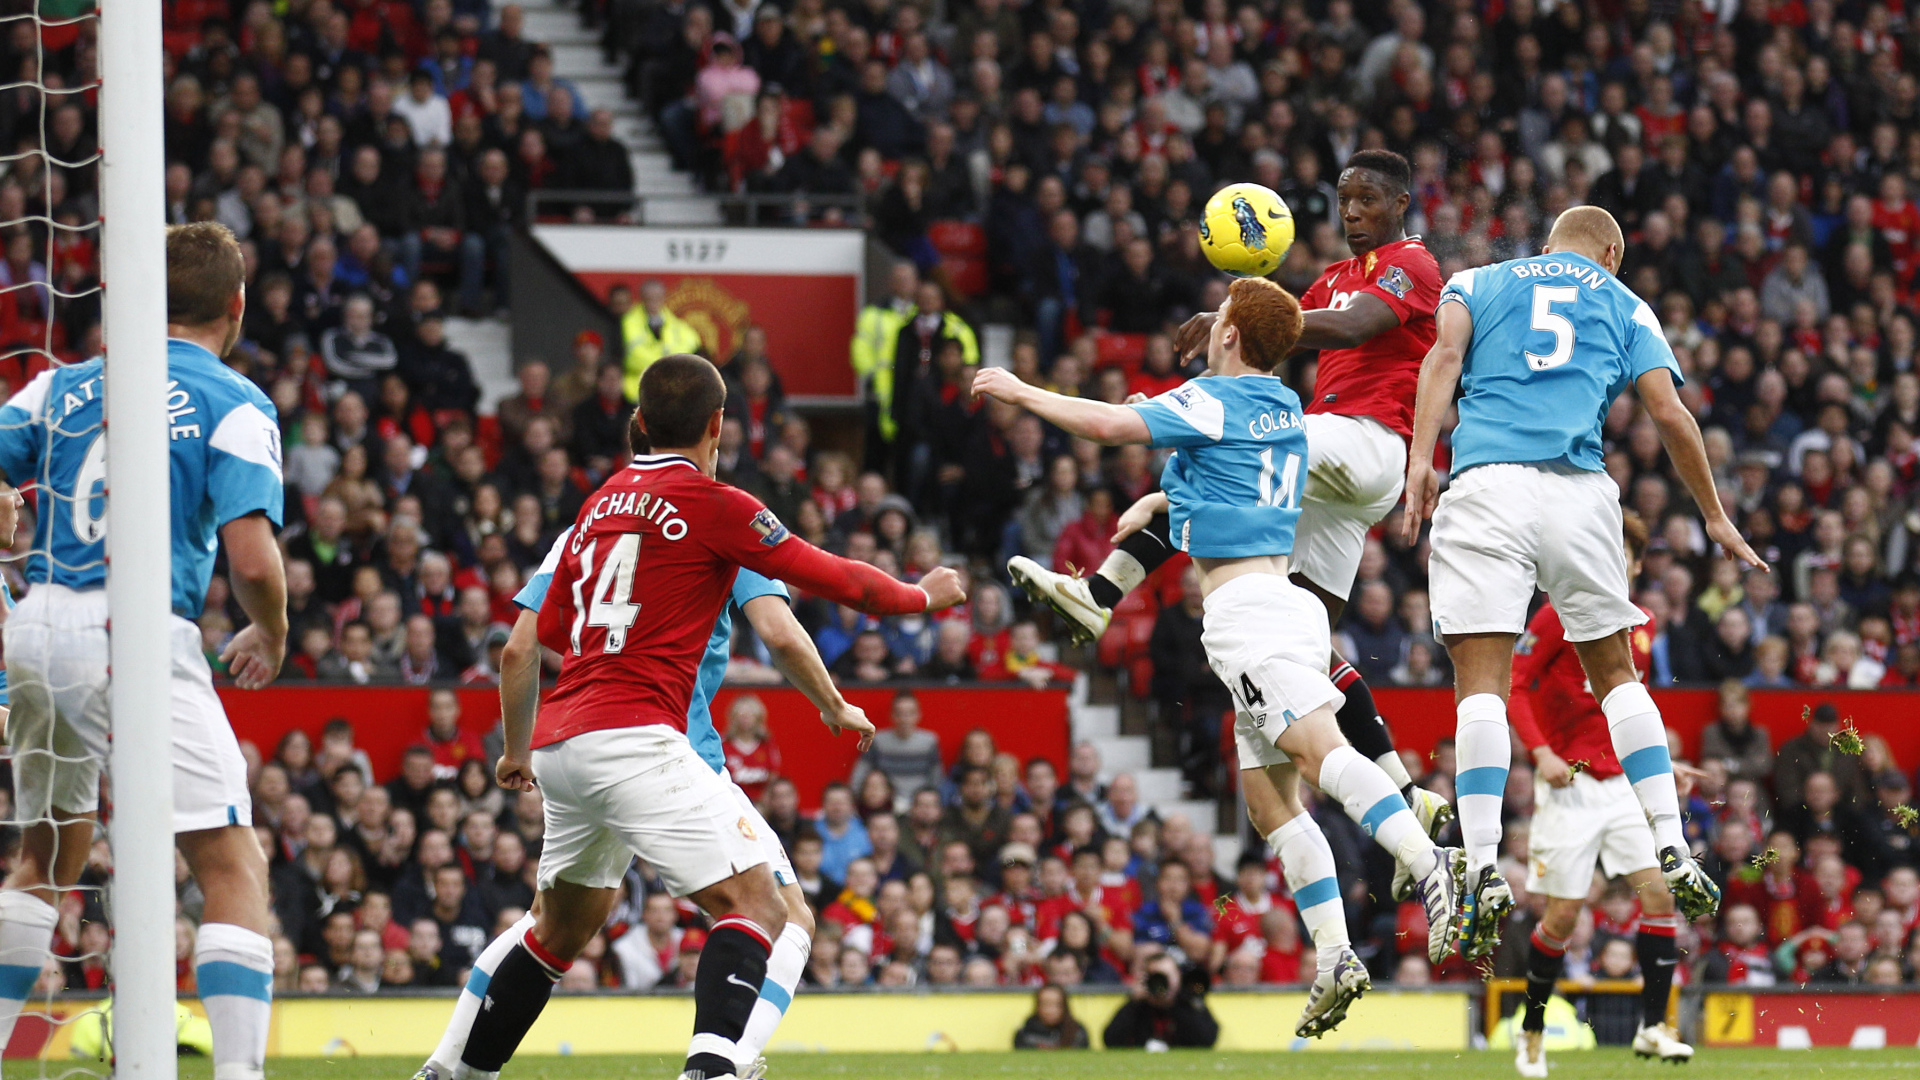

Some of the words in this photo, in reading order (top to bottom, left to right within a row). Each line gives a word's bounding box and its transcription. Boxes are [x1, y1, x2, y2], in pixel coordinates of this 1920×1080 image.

[1511, 262, 1608, 290] BROWN
[1524, 284, 1579, 371] 5
[1248, 410, 1308, 439] COLBA
[1256, 445, 1302, 508] 14
[571, 492, 688, 555] CHICHARITO
[570, 532, 643, 657] 14
